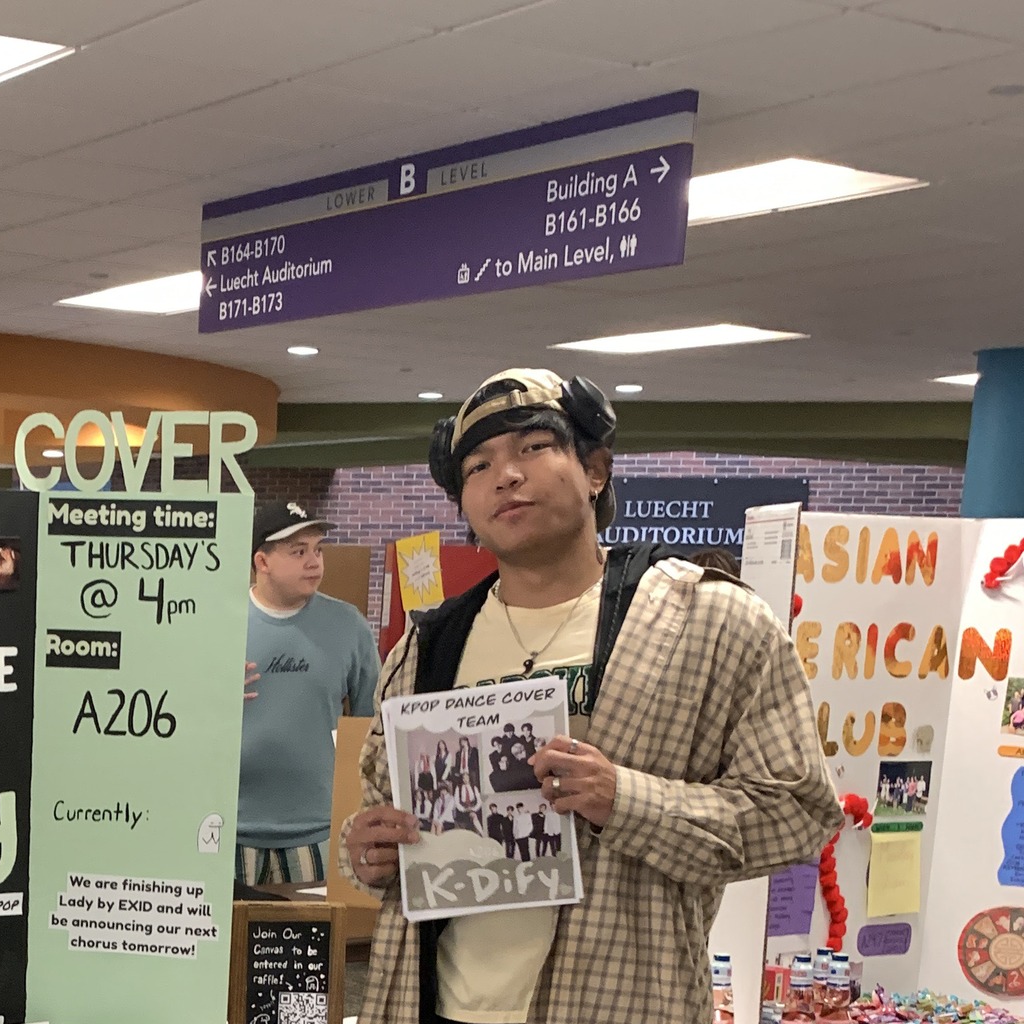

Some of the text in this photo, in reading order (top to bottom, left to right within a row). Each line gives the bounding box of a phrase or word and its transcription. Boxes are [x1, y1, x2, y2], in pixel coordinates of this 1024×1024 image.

[326, 162, 488, 211] LOWER B LEVEL
[546, 165, 639, 203] Building A
[545, 200, 641, 236] B161-B166
[221, 234, 286, 266] B164-B170
[494, 241, 615, 278] to Main Level,
[220, 256, 333, 294] Luecht Auditorium
[219, 293, 283, 321] B171-B173
[14, 408, 258, 496] COVER
[48, 503, 215, 533] Meeting time:
[623, 499, 714, 519] LUECHT
[60, 540, 221, 572] THURSDAY'S
[80, 577, 196, 625] @ 4pm
[46, 633, 118, 658] Room:
[796, 621, 1013, 681] ERICAN
[264, 653, 310, 674] Hollister
[72, 688, 177, 739] A206
[400, 687, 556, 716] KPOP DANCE COVER
[457, 713, 501, 730] TEAM
[817, 701, 907, 757] LUB
[53, 800, 149, 830] Currently:
[69, 875, 204, 898] We are finishing up
[59, 895, 211, 917] Lady by EXID and will
[51, 914, 217, 938] be announcing our next
[253, 926, 302, 940] Join Our
[70, 936, 196, 956] chorus tomorrow!
[253, 944, 318, 956] Canvas to be
[253, 960, 324, 971] entered in our
[253, 974, 284, 985] raffle!
